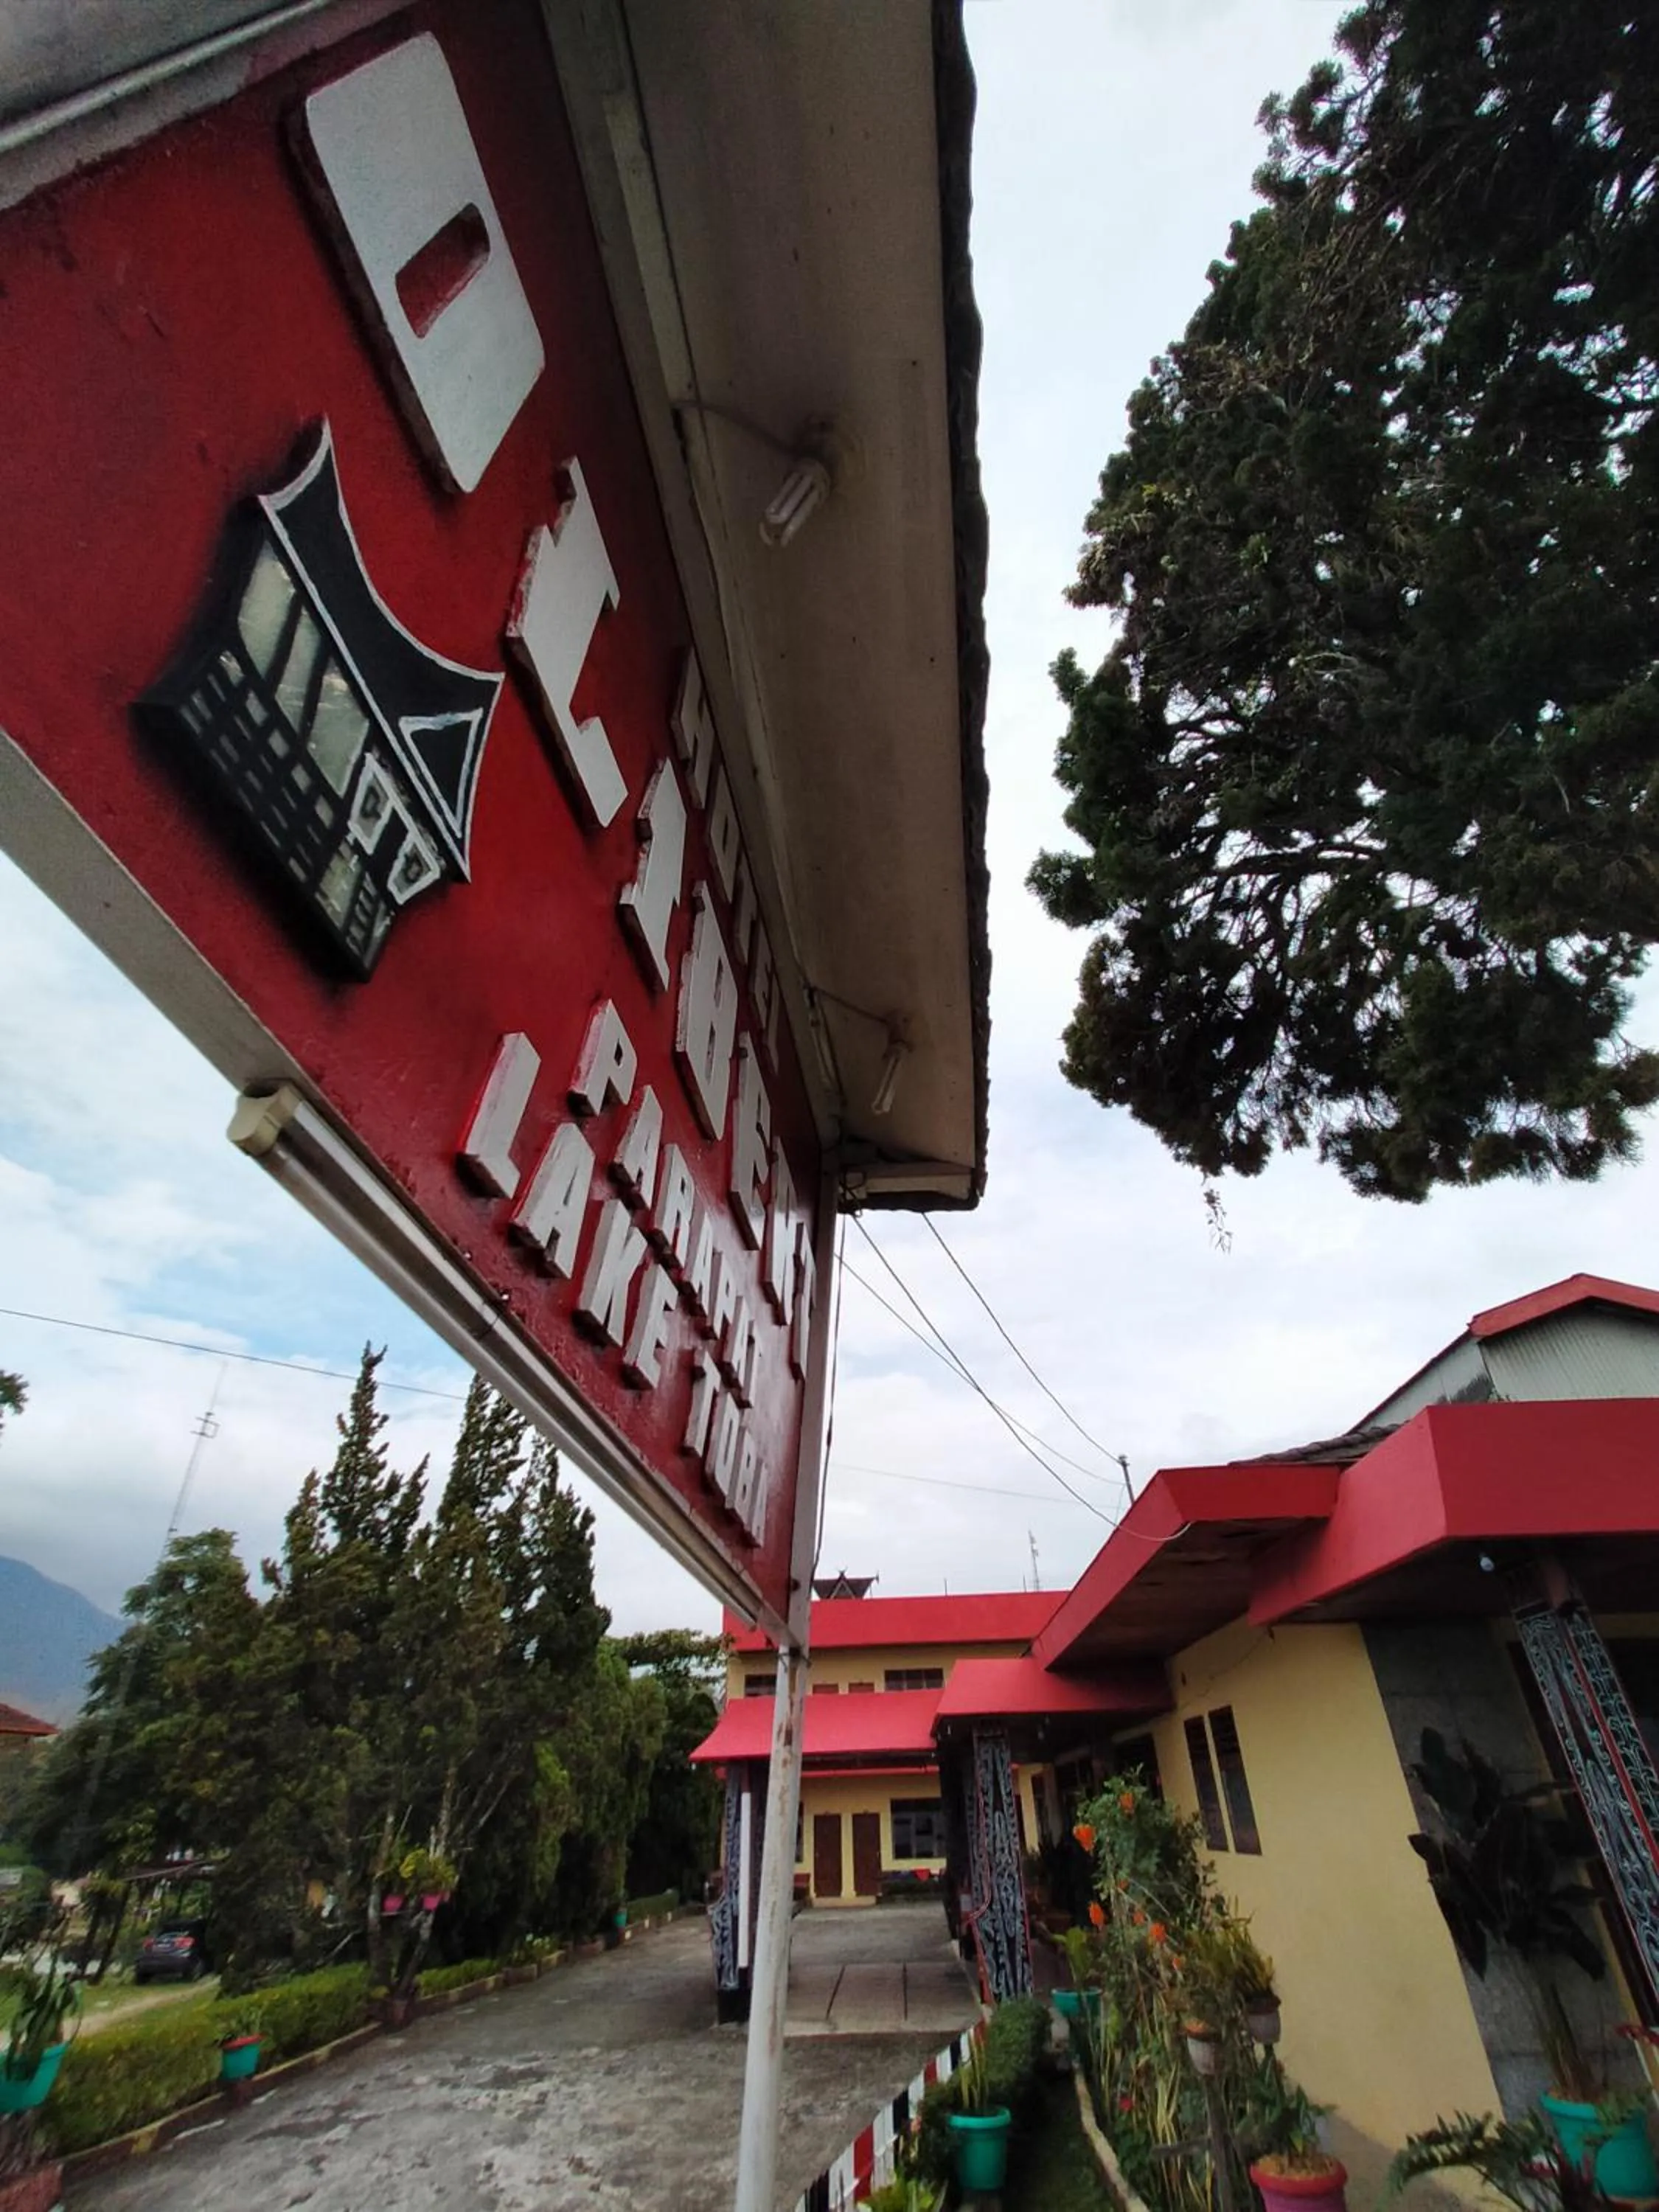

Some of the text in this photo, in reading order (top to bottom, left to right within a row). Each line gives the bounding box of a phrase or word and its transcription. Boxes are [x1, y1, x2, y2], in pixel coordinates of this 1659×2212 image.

[306, 31, 816, 1382] OLIBERT
[674, 646, 779, 1077] HOTEL
[464, 1032, 768, 1547] LAKE TOBA
[571, 999, 762, 1407] PARAPAT
